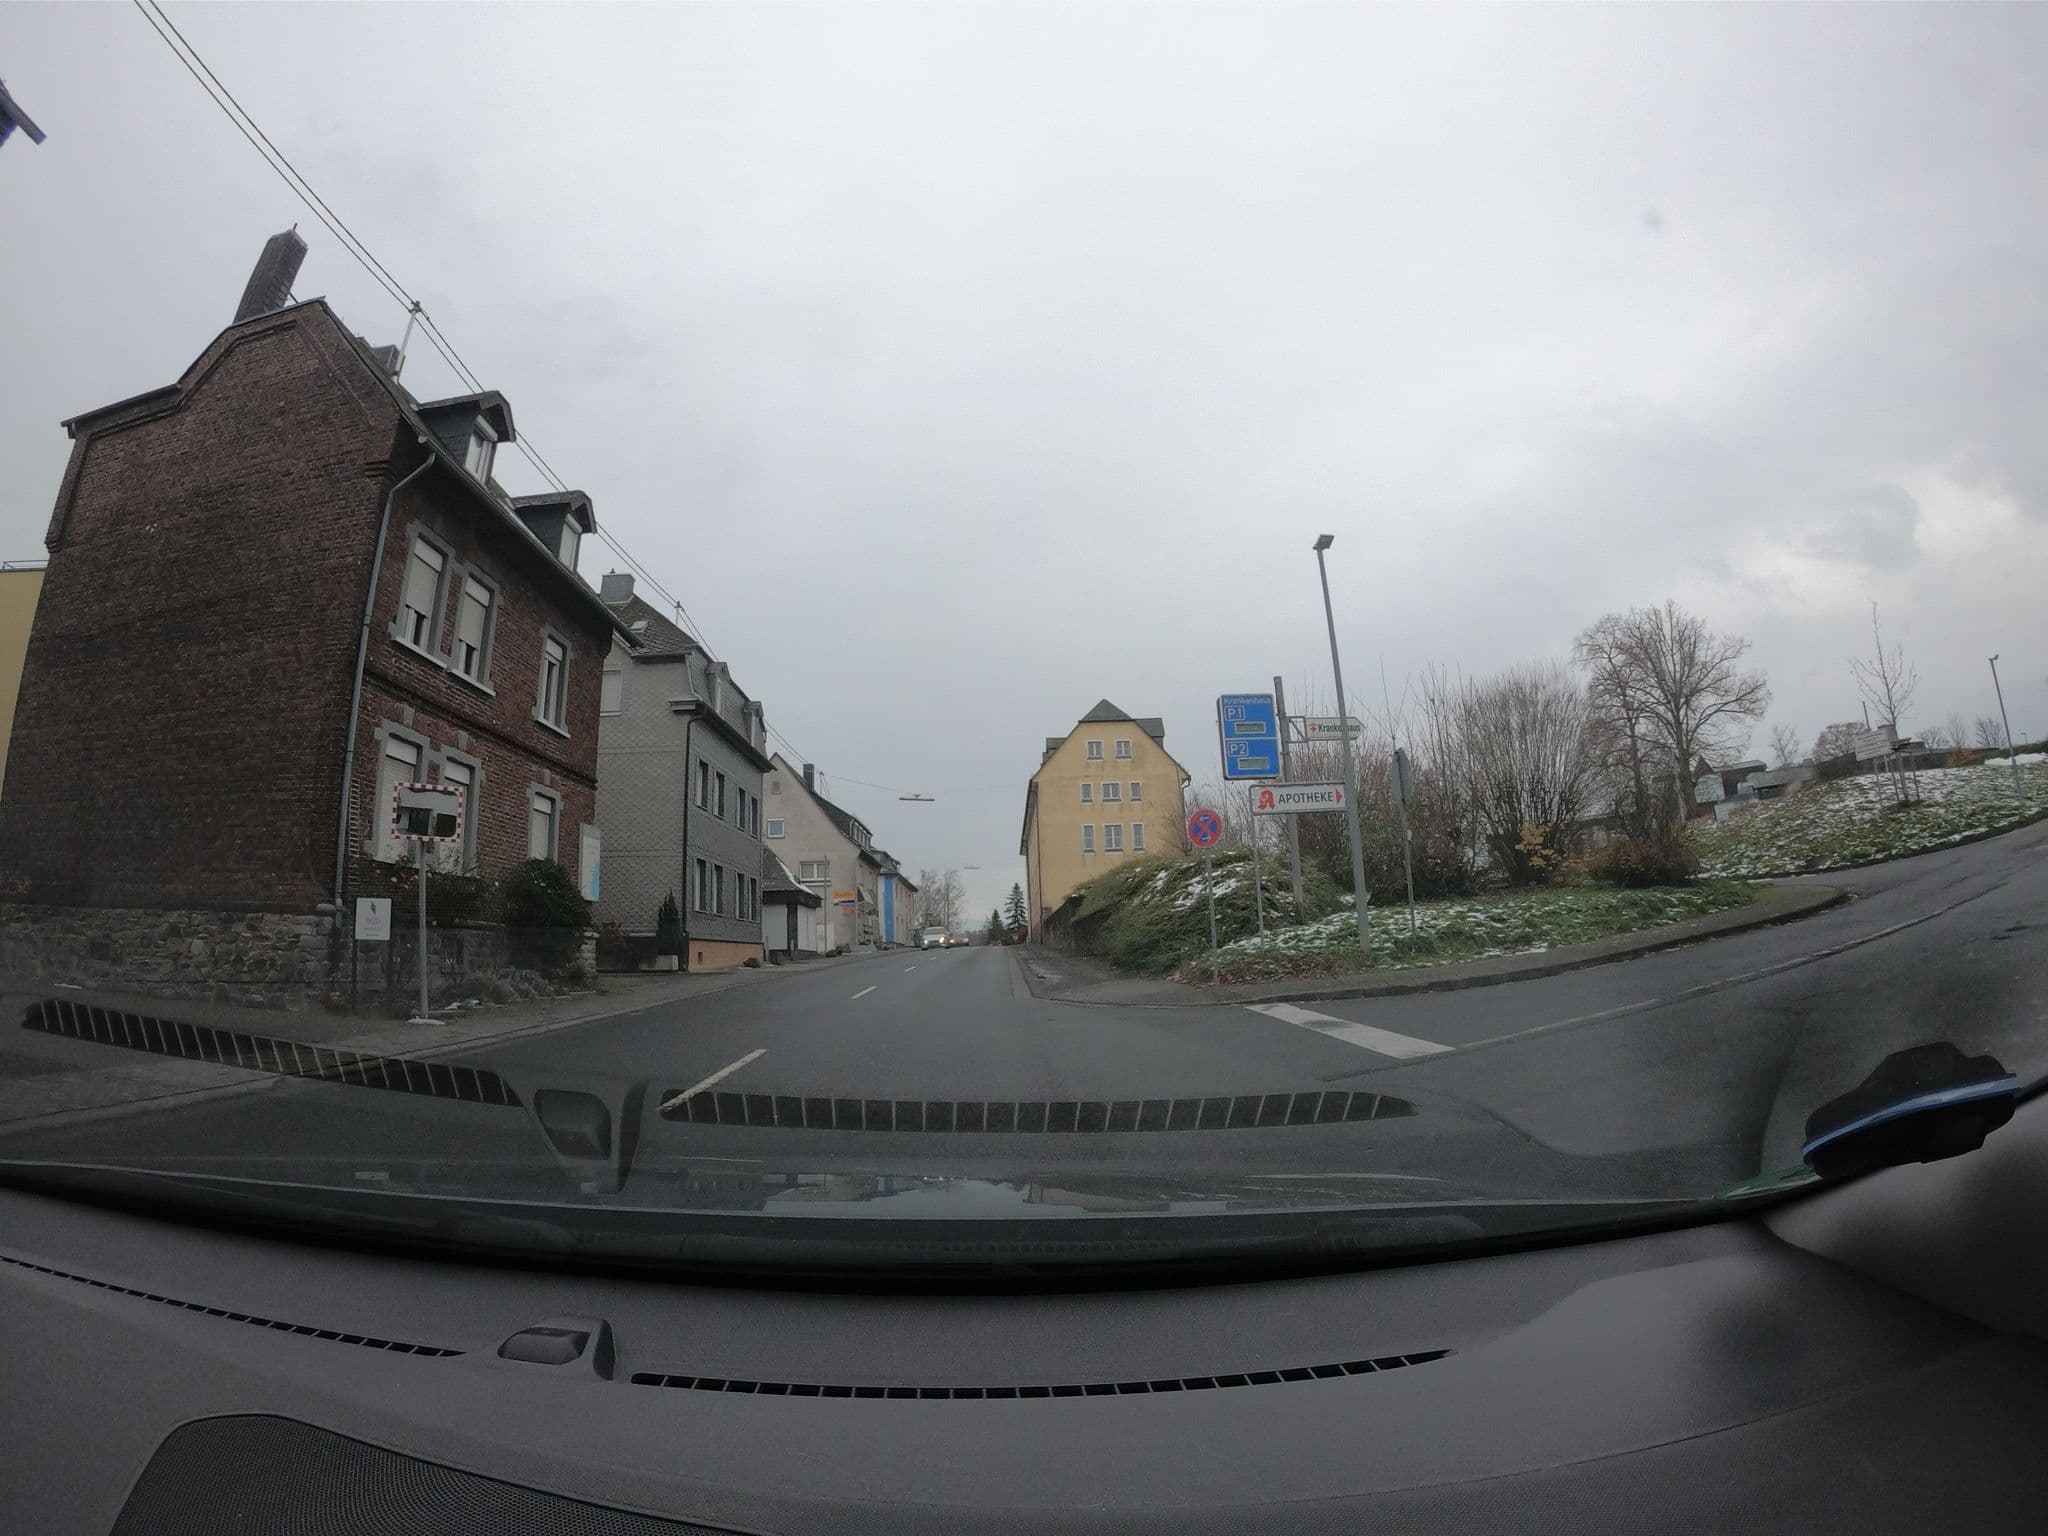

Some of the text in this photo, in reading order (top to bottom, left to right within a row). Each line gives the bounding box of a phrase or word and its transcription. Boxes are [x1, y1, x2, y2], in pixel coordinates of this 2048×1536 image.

[1227, 707, 1242, 719] P1
[1318, 723, 1361, 732] Krankeaus
[1230, 743, 1246, 755] P2
[1278, 791, 1334, 804] APOTHEKE
